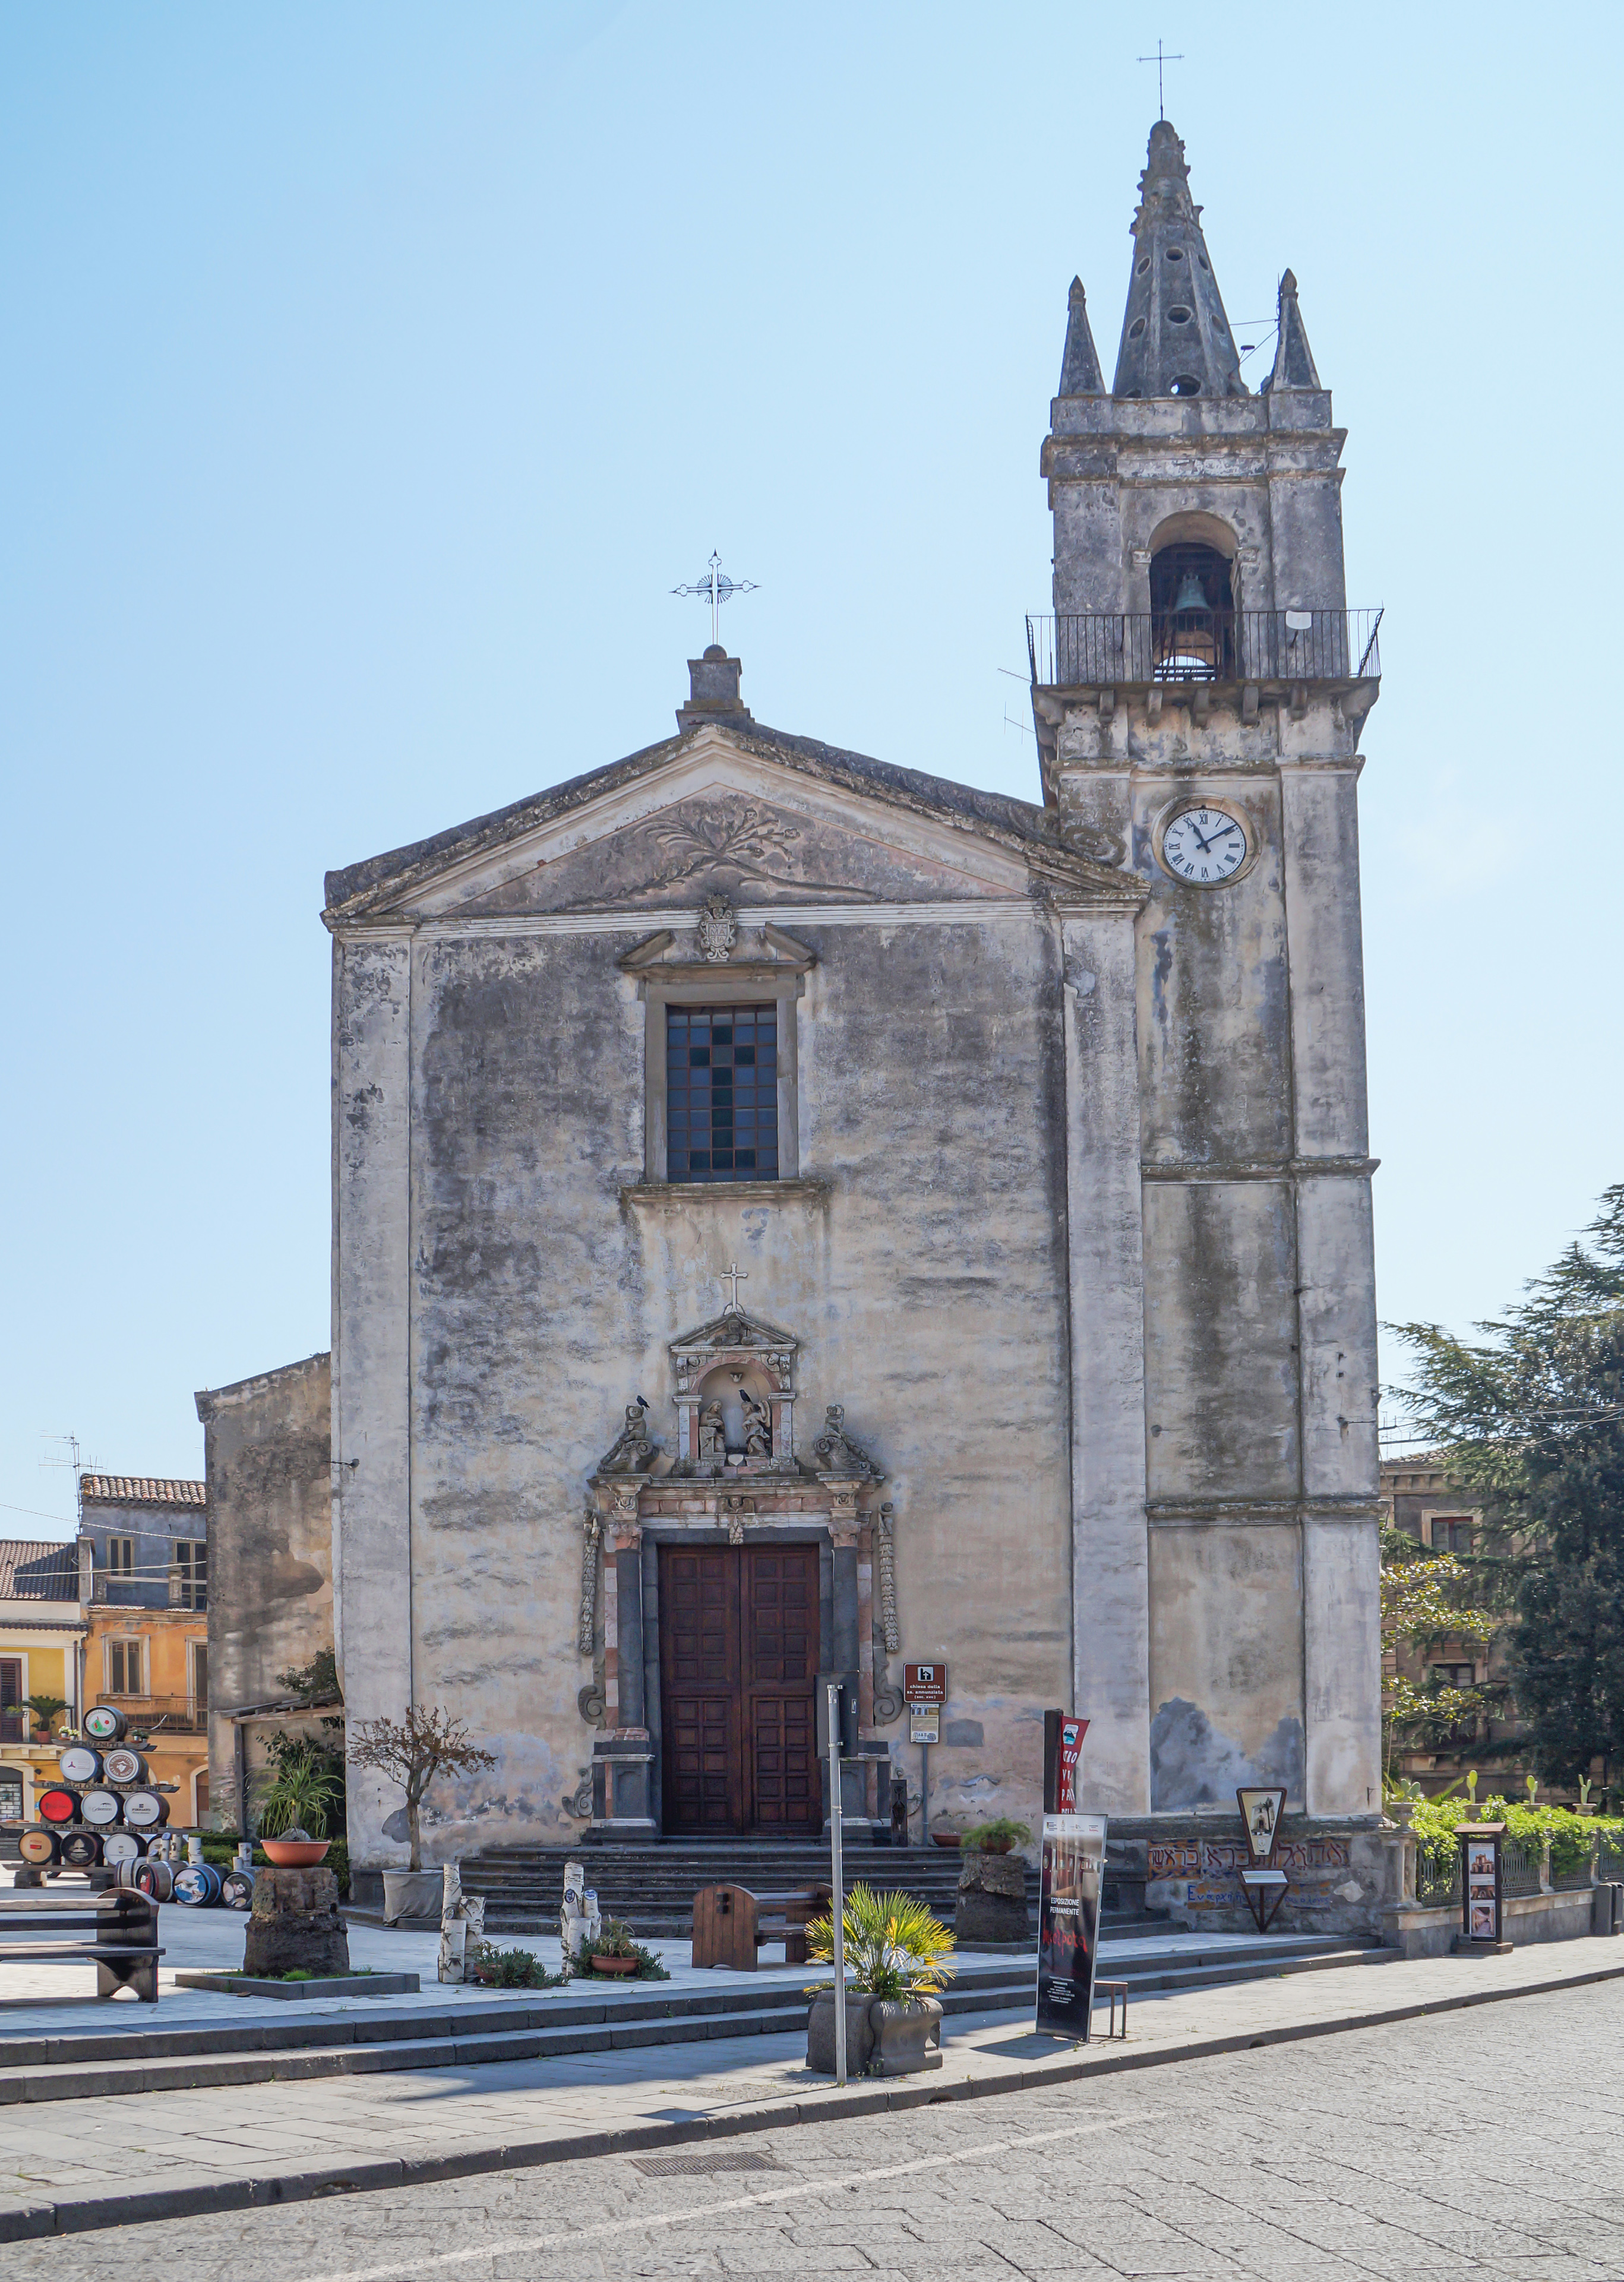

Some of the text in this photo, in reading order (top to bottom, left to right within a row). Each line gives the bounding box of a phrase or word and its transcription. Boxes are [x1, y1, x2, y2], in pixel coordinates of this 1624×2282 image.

[1199, 814, 1208, 824] XII
[1171, 828, 1184, 837] X
[1217, 864, 1225, 874] V
[1051, 1897, 1080, 1906] ESPOSIZIONE
[1050, 1907, 1080, 1915] PERMANENTE
